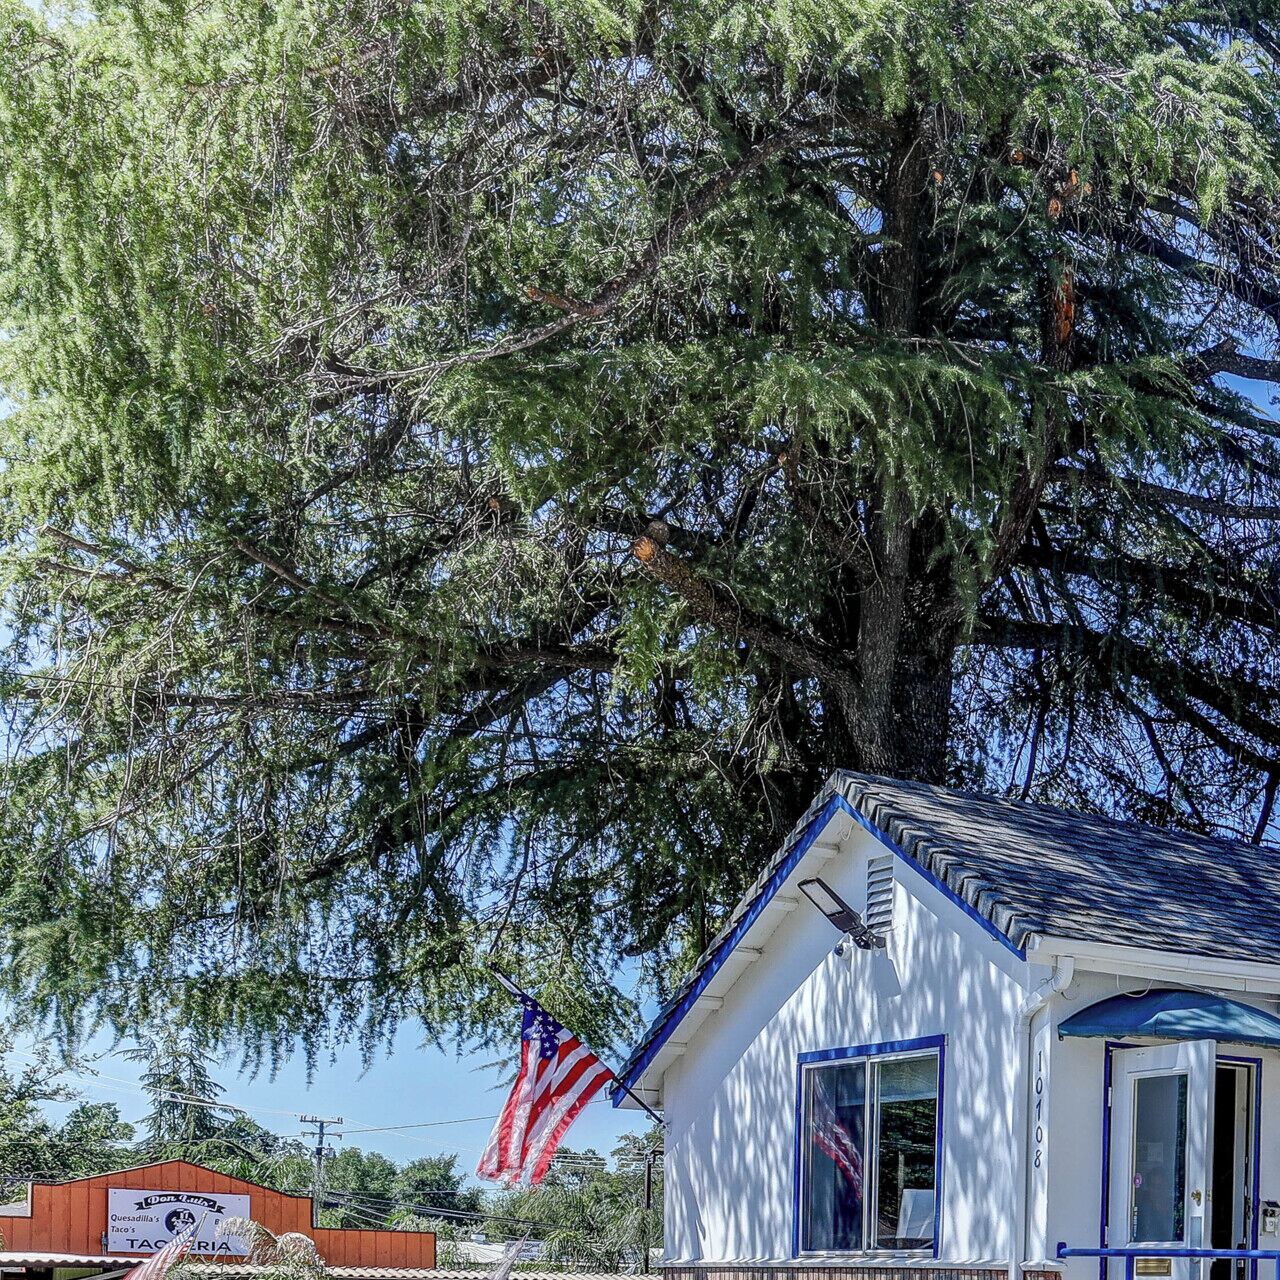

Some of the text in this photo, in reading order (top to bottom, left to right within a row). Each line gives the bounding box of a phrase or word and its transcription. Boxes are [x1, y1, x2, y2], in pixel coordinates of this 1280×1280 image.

[1034, 1051, 1043, 1168] 10108
[148, 1196, 177, 1204] Don
[111, 1214, 160, 1222] Quesadilla's
